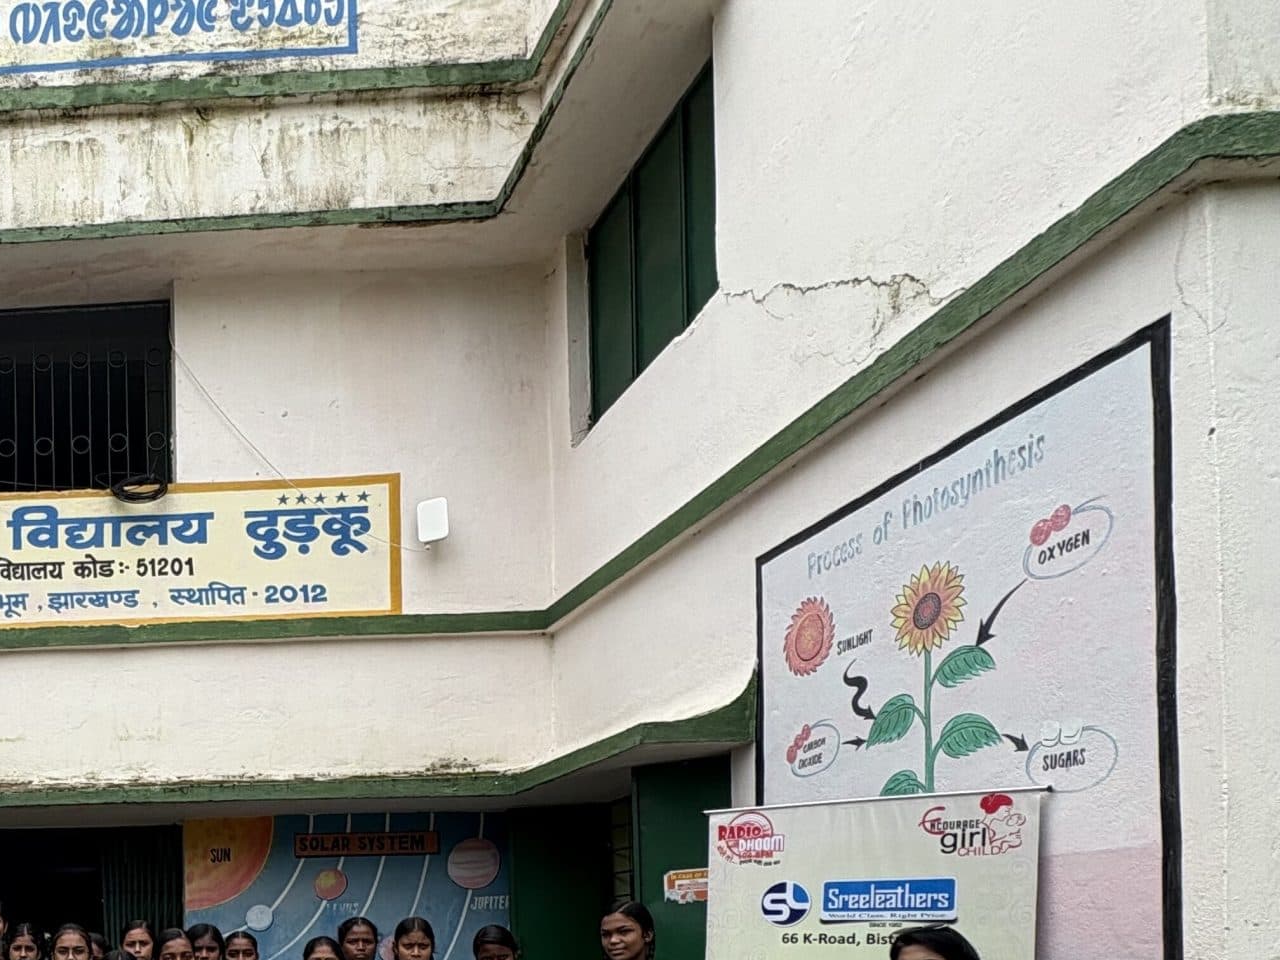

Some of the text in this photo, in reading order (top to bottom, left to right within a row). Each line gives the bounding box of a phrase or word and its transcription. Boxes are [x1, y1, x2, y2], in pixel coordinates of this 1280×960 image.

[806, 432, 1046, 580] Process of Photosynthesis
[7, 504, 214, 551] विद्यालय
[244, 505, 372, 560] दुड़कू
[1037, 528, 1091, 565] OXYGEN
[136, 557, 196, 578] 51201
[47, 590, 140, 612] झारखण्ड
[169, 581, 247, 607] स्थापित
[264, 584, 328, 604] 2012
[836, 628, 874, 656] SUNLIGHT
[1042, 747, 1087, 772] SUGARS
[297, 833, 426, 851] SOLAR SYSTEM
[718, 824, 762, 842] RADIO
[738, 834, 785, 852] DHOOM
[939, 828, 988, 855] girl
[209, 847, 232, 864] SUN
[957, 845, 1002, 858] CHILD
[827, 887, 950, 911] Sreeleathers
[781, 931, 894, 947] 66 K-Road, Bist
